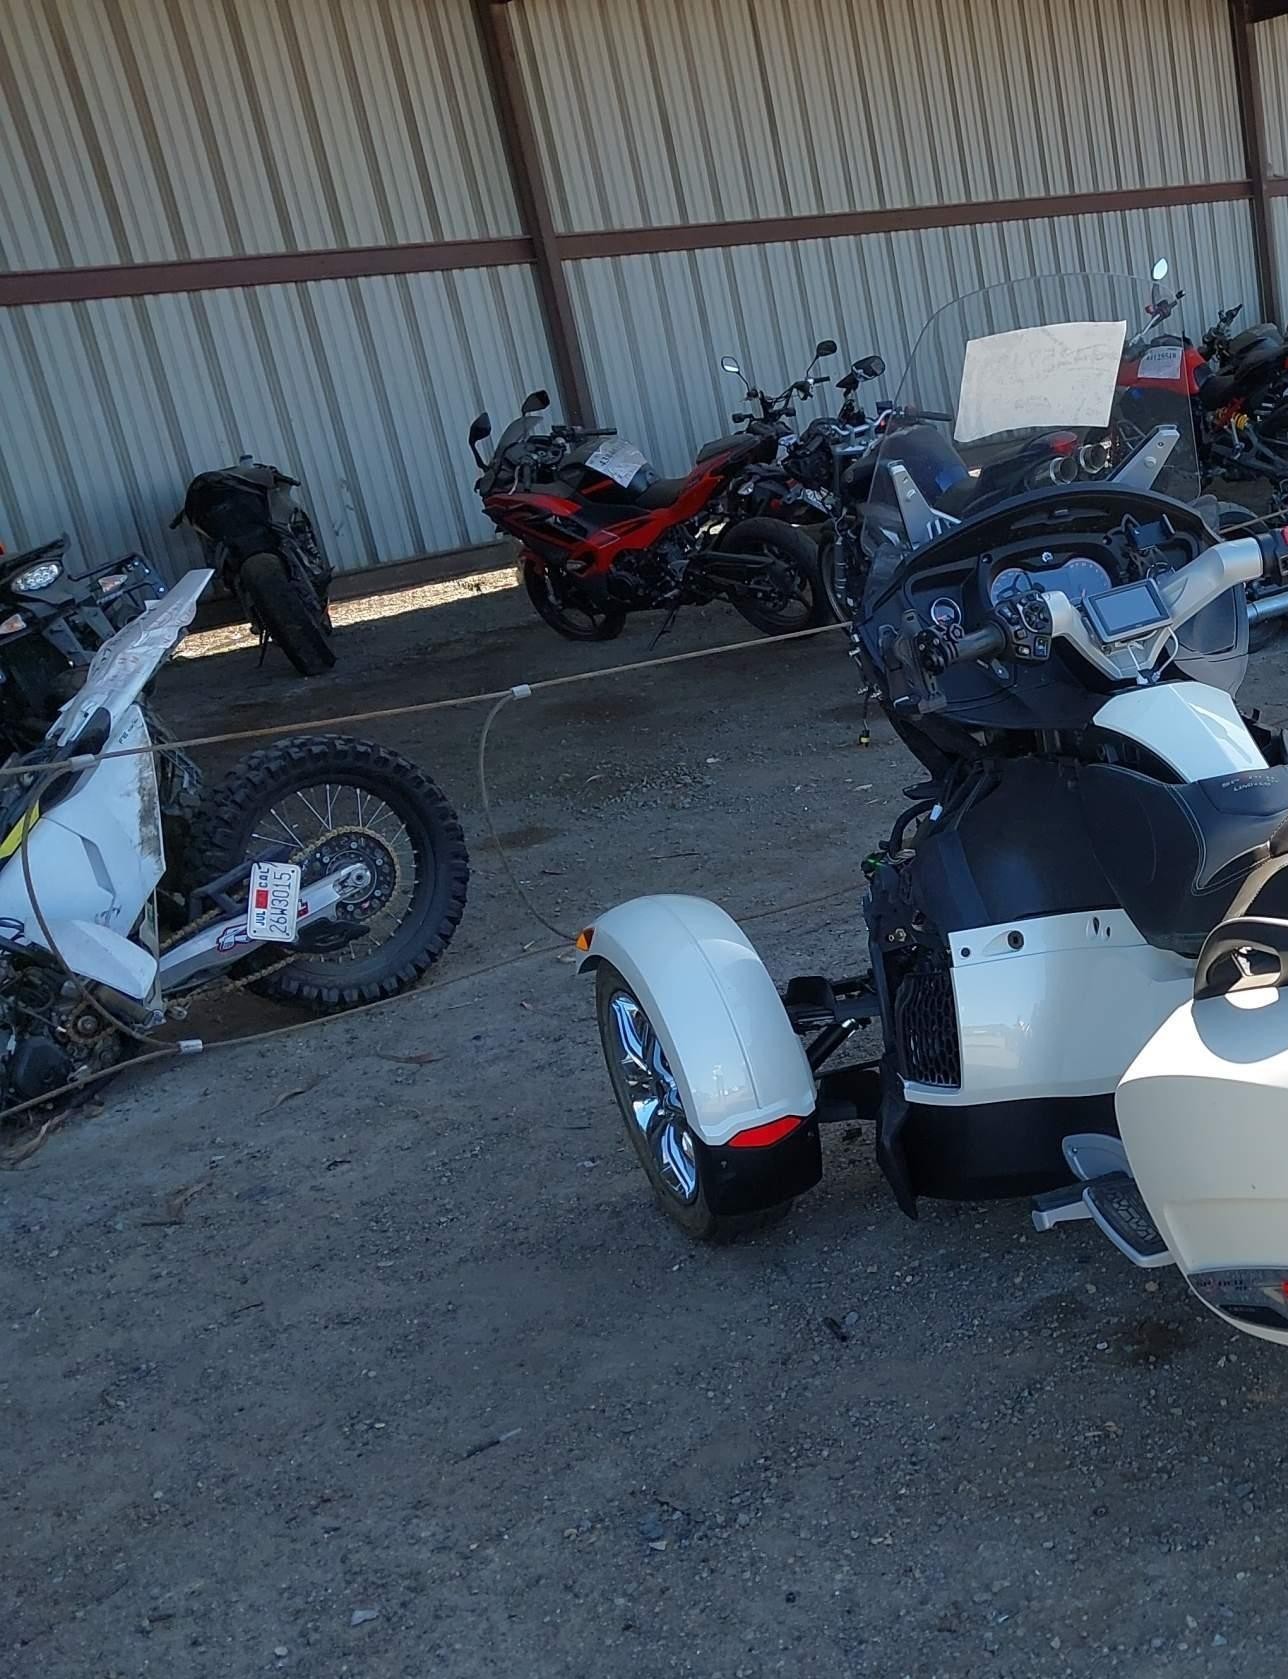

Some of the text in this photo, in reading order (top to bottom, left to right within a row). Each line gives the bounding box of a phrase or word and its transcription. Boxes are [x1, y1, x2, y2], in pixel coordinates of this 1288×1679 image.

[258, 868, 270, 888] CAL
[269, 871, 292, 934] 26W3015
[255, 910, 266, 927] JUL
